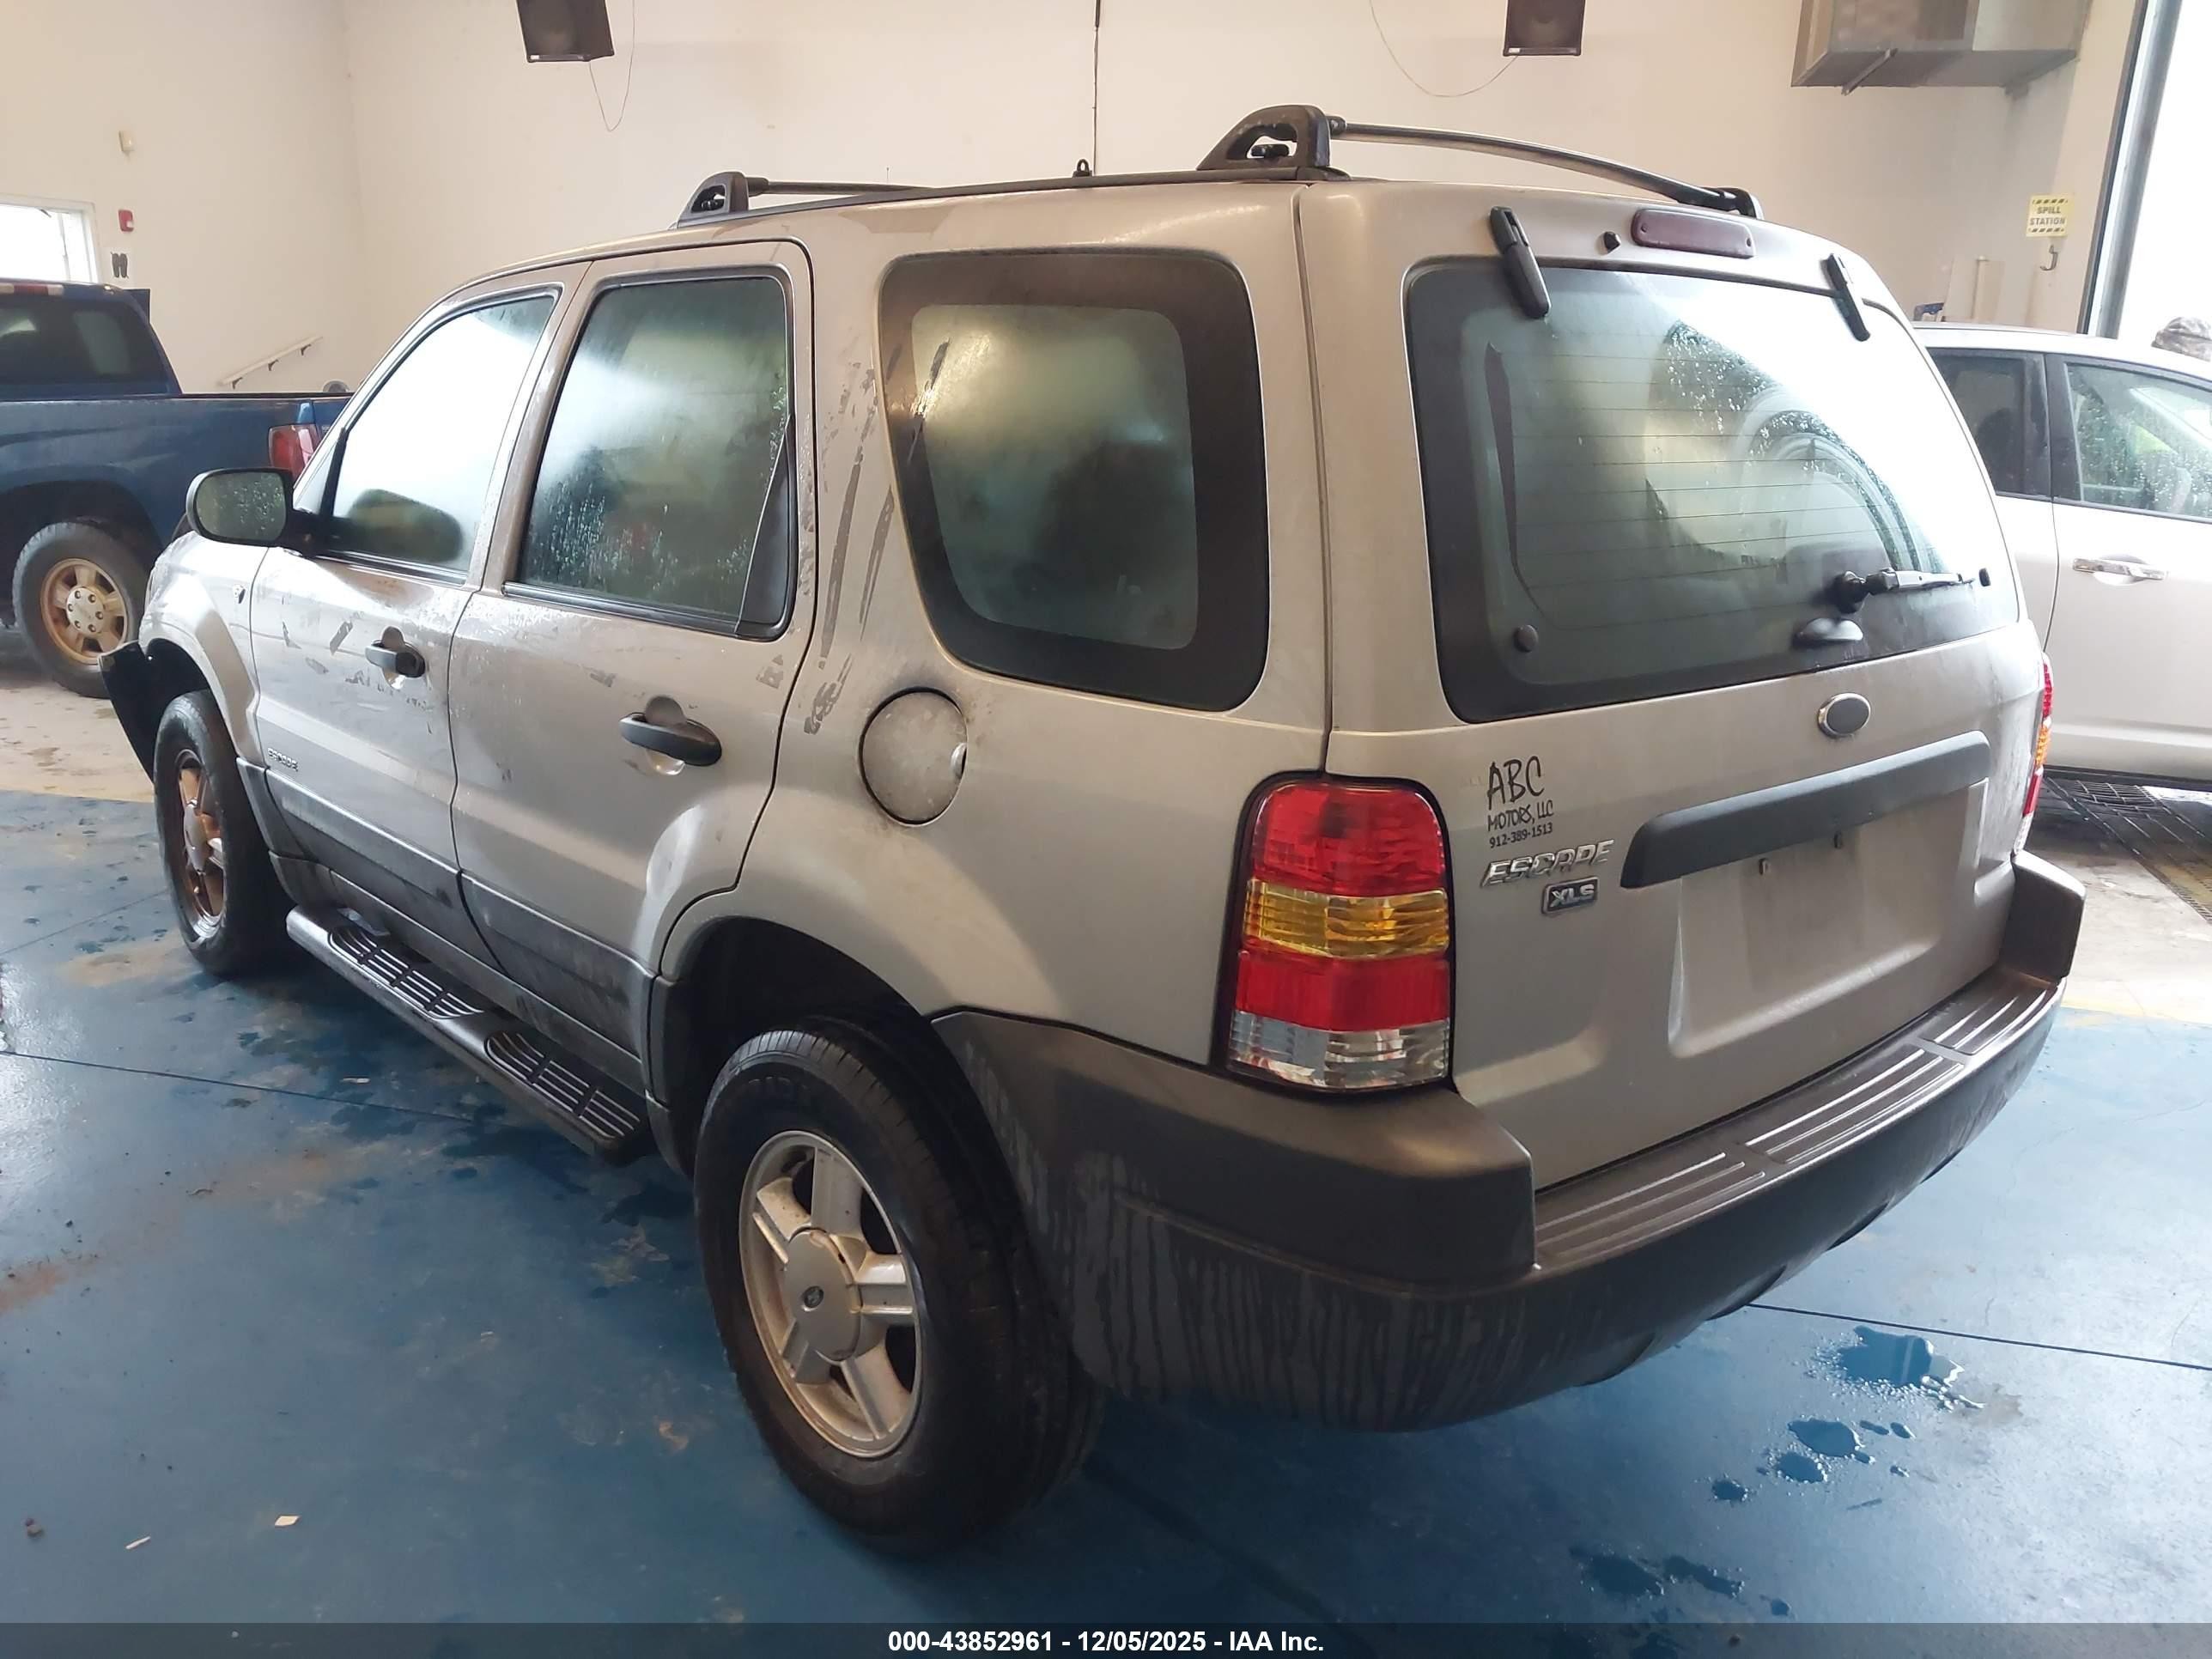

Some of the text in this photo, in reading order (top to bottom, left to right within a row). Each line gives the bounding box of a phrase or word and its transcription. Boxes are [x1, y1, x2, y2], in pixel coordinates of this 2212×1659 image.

[2029, 217, 2065, 226] STATION
[1486, 756, 1546, 811] ABC
[1537, 799, 1554, 819] LLC
[1489, 822, 1553, 848] 912-389-1513
[1480, 839, 1614, 888] ESCAPE
[1549, 884, 1595, 908] XLS
